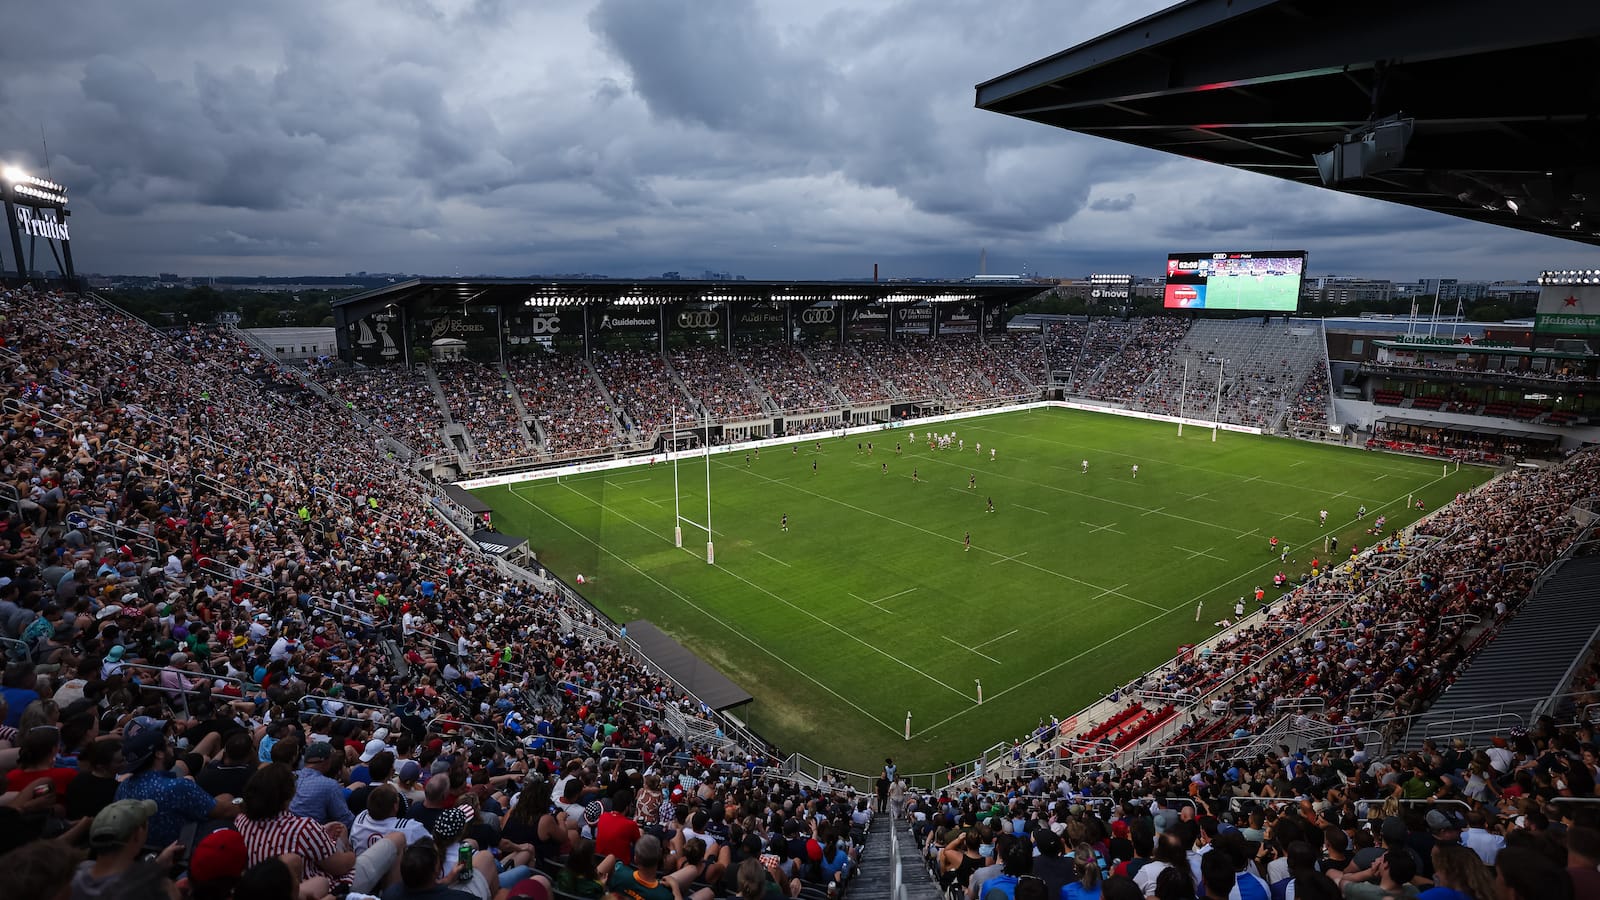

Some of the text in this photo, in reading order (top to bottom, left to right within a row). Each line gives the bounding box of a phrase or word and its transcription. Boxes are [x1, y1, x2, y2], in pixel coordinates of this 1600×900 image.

[17, 208, 70, 240] Fruitist
[533, 317, 560, 334] DC
[1540, 315, 1597, 326] Heineken
[450, 324, 484, 332] SCORES
